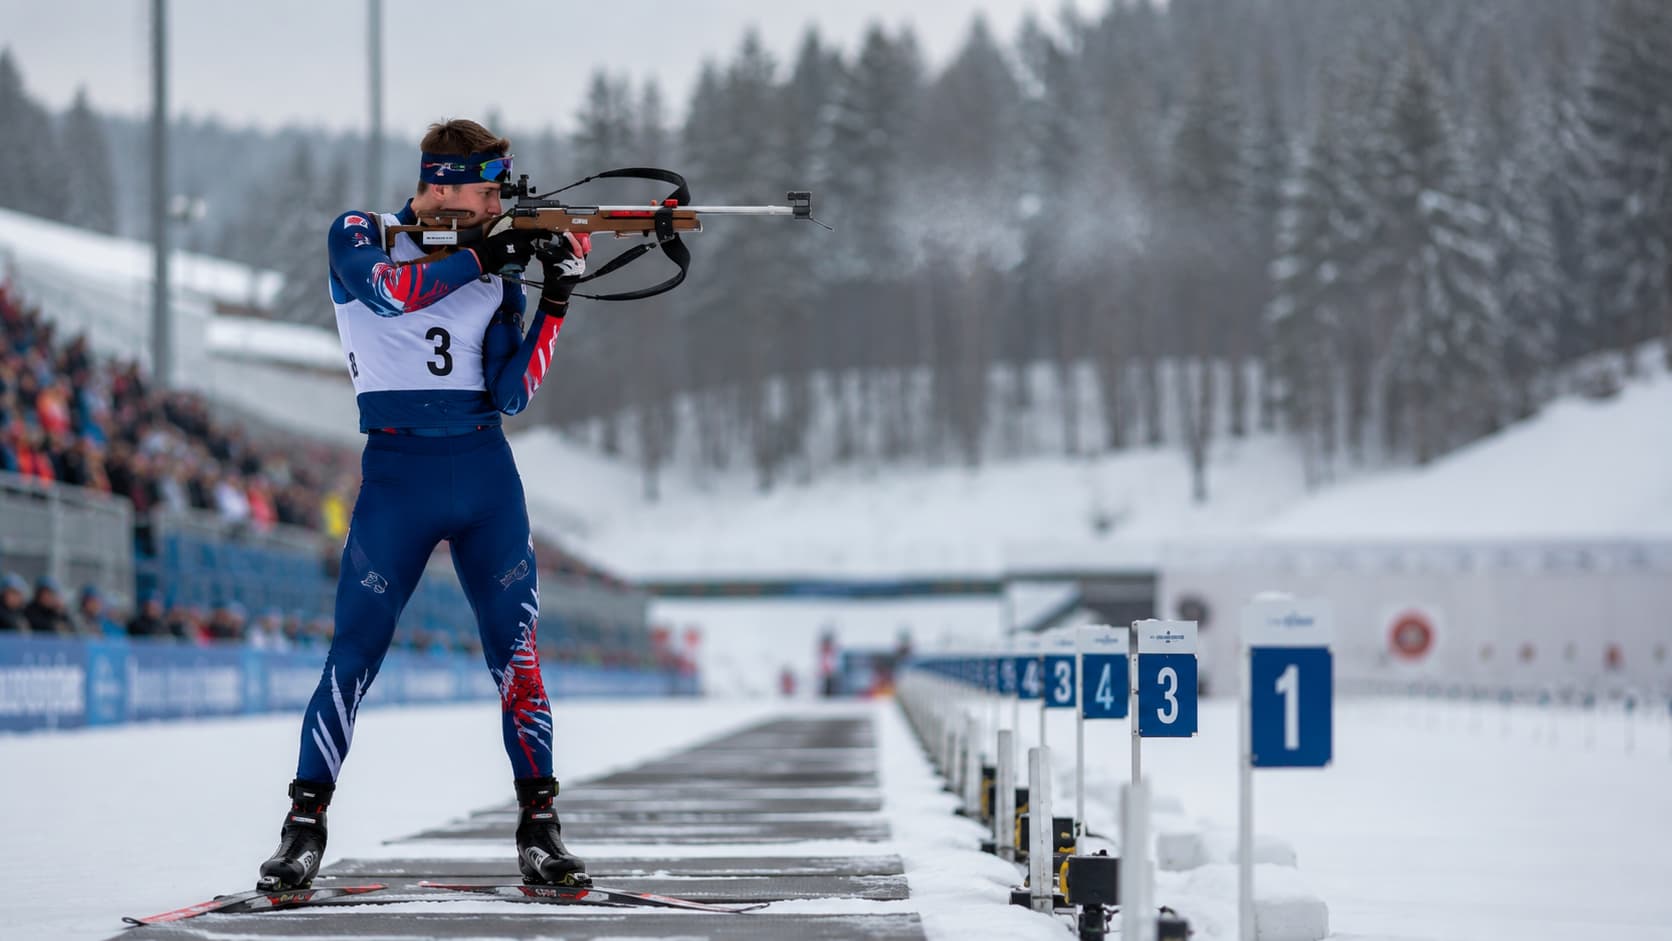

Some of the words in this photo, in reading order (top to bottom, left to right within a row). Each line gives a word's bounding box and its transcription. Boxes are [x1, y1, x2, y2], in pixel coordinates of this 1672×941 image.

[425, 327, 453, 376] 3
[1021, 660, 1039, 696] 4
[1054, 660, 1072, 703] 3
[1095, 663, 1114, 711] 4
[1157, 667, 1179, 724] 3
[1275, 665, 1299, 750] 1
